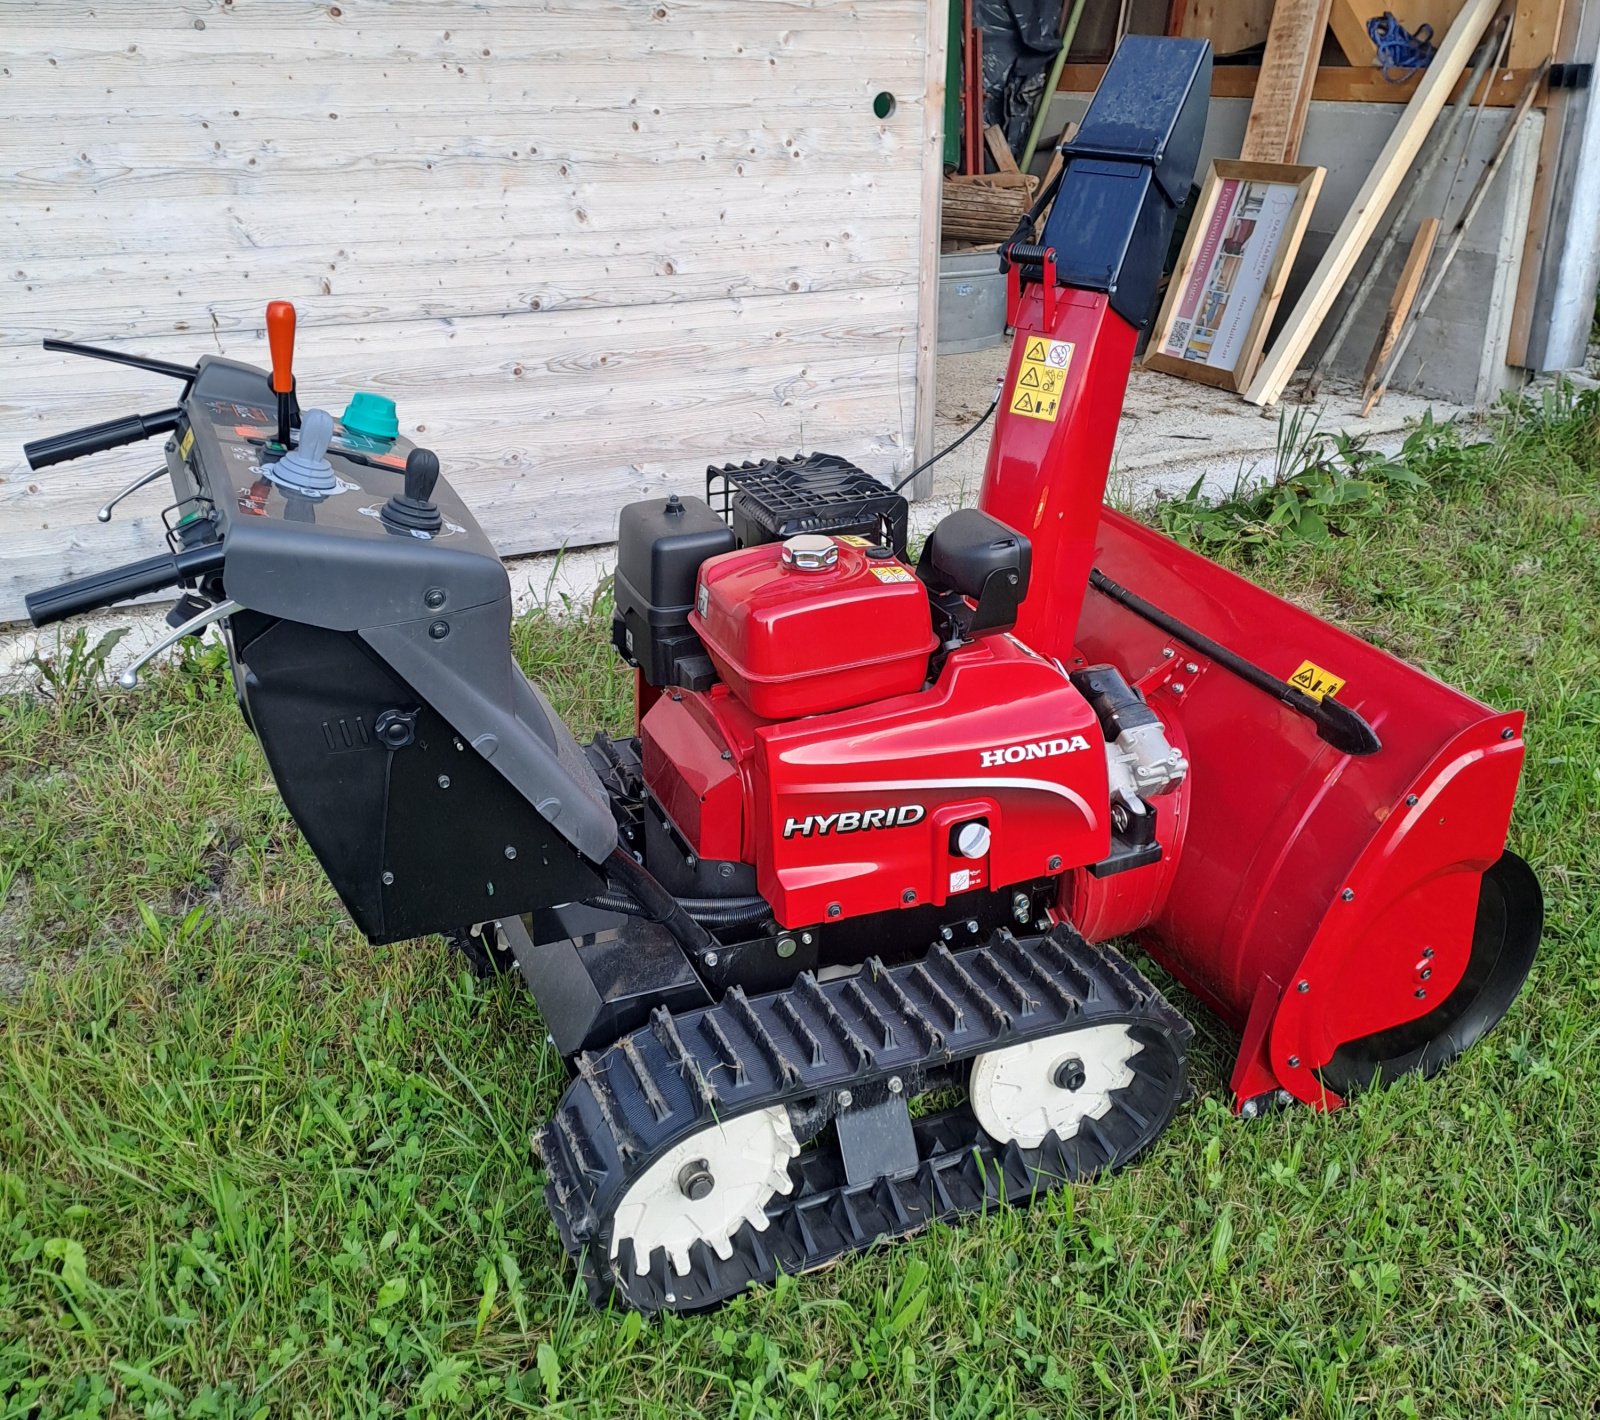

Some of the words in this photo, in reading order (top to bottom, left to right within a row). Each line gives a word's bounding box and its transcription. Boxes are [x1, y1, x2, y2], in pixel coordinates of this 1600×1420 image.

[1271, 219, 1281, 238] DAS
[1255, 240, 1273, 281] HABITAT
[980, 735, 1091, 768] HONDA
[783, 804, 926, 838] HYBRID
